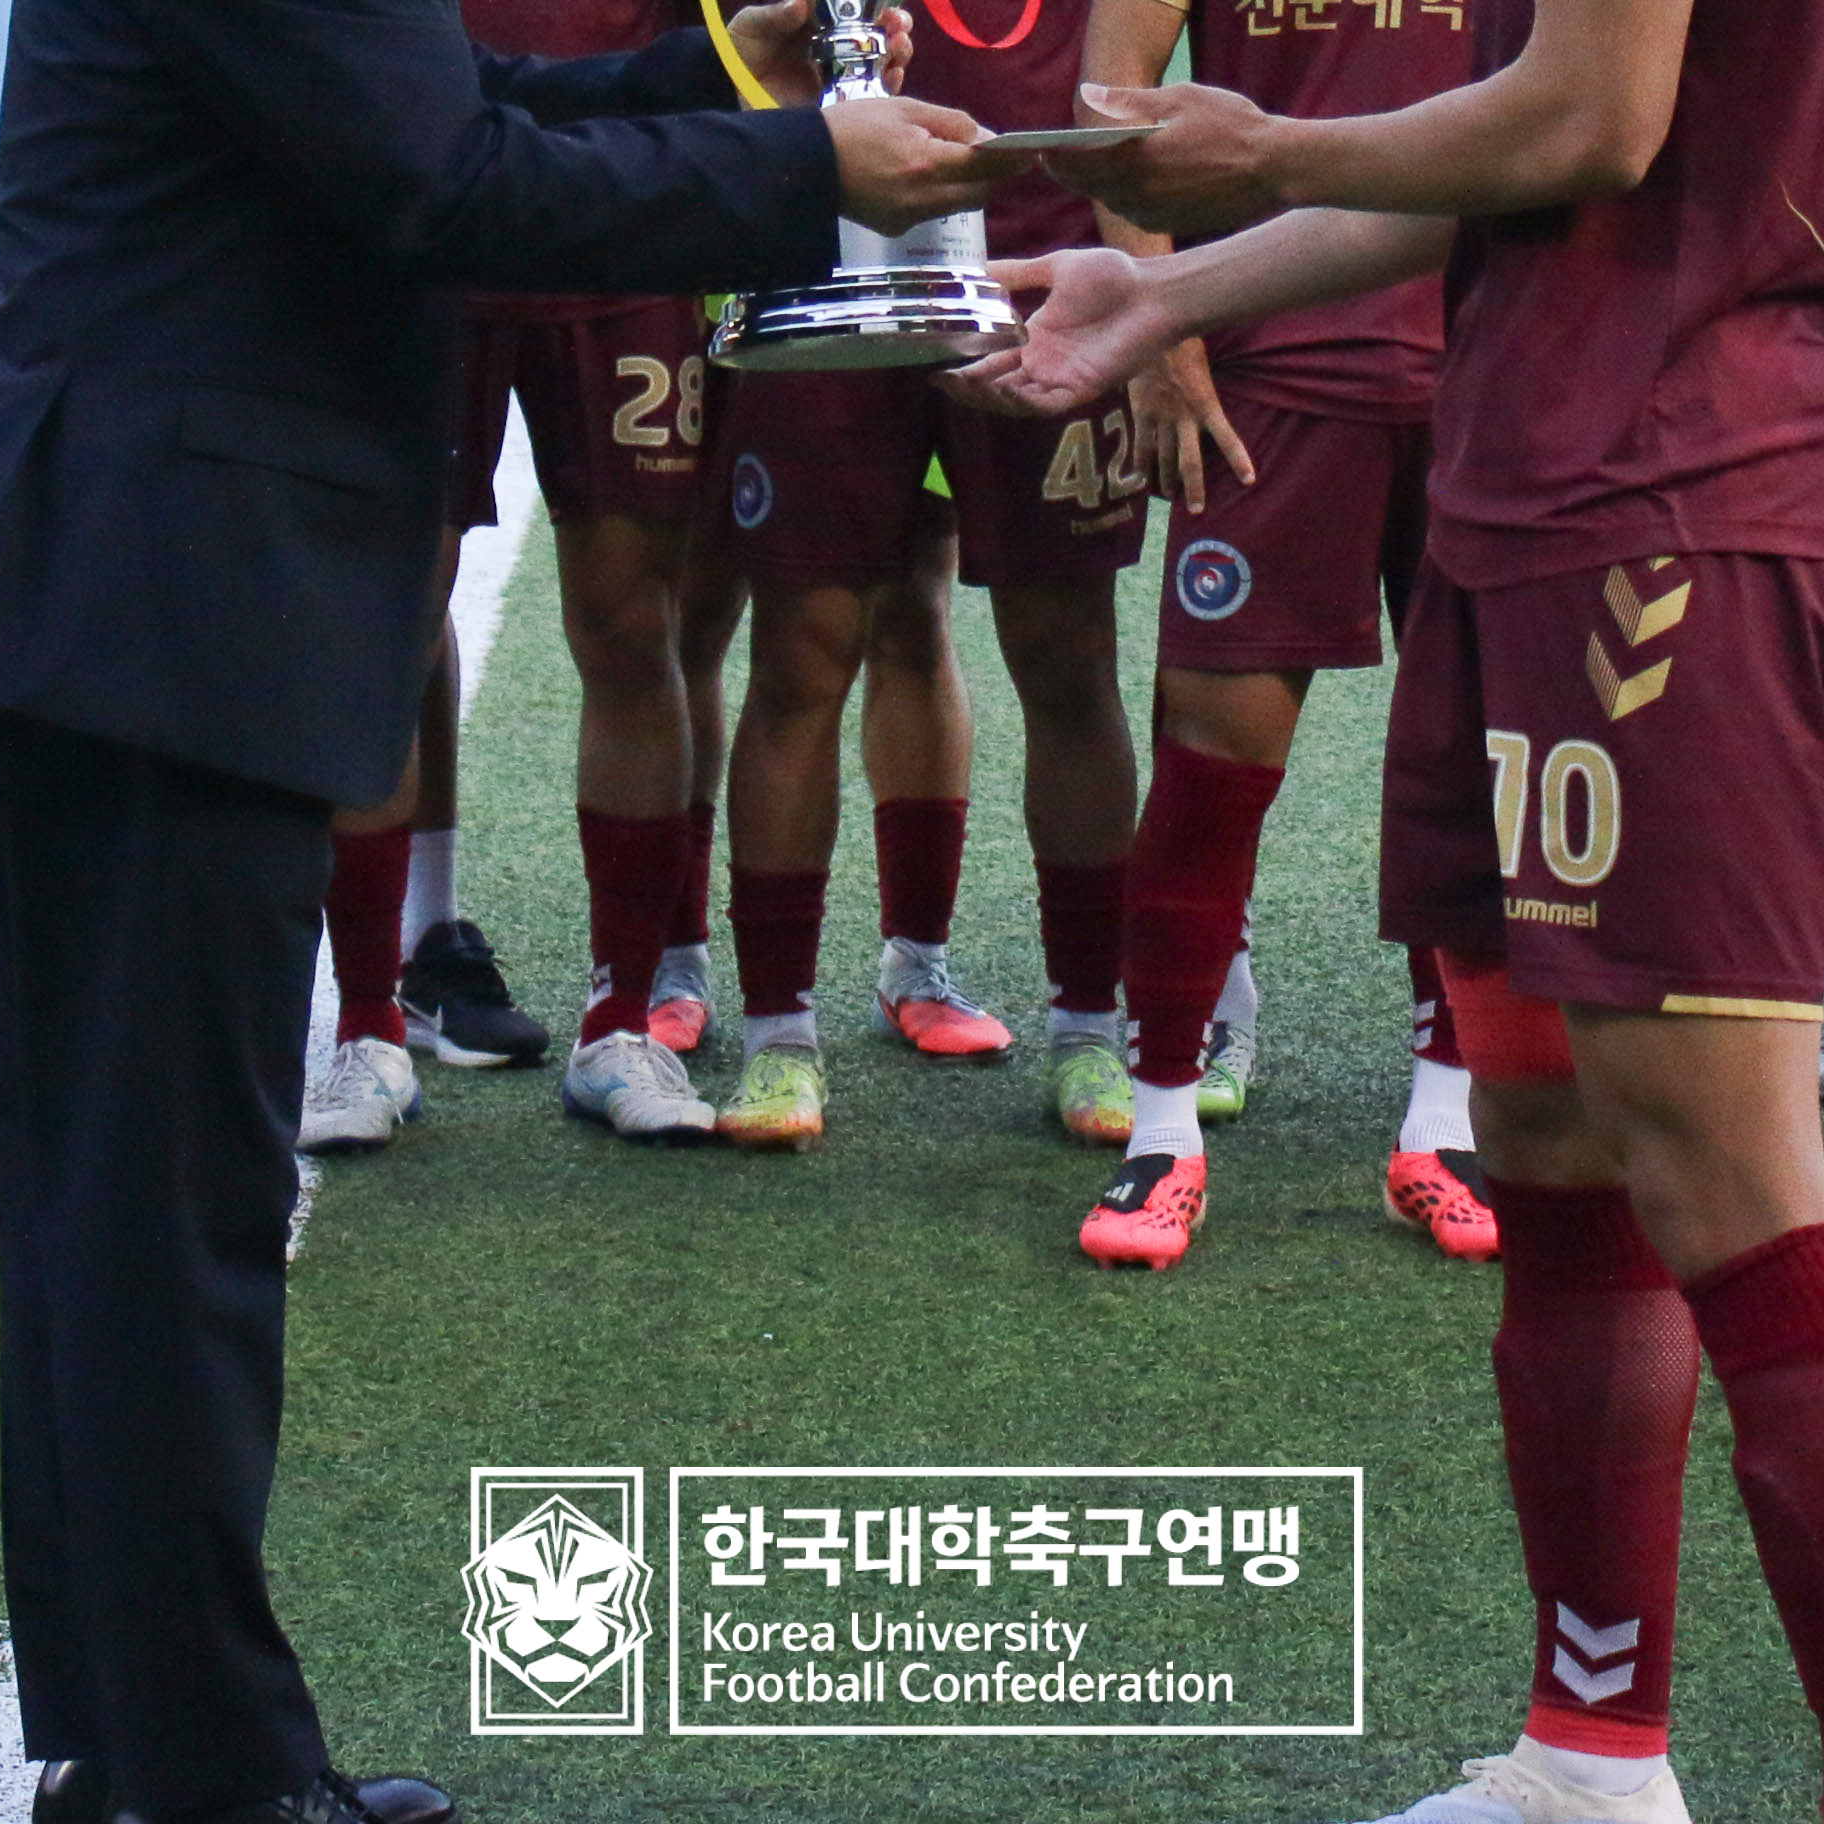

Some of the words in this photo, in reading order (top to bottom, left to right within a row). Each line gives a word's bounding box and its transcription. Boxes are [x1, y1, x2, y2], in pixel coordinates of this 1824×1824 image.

[613, 354, 704, 447] 28
[1042, 408, 1148, 509] 42
[1486, 728, 1622, 888] 10
[1503, 896, 1599, 928] ummel
